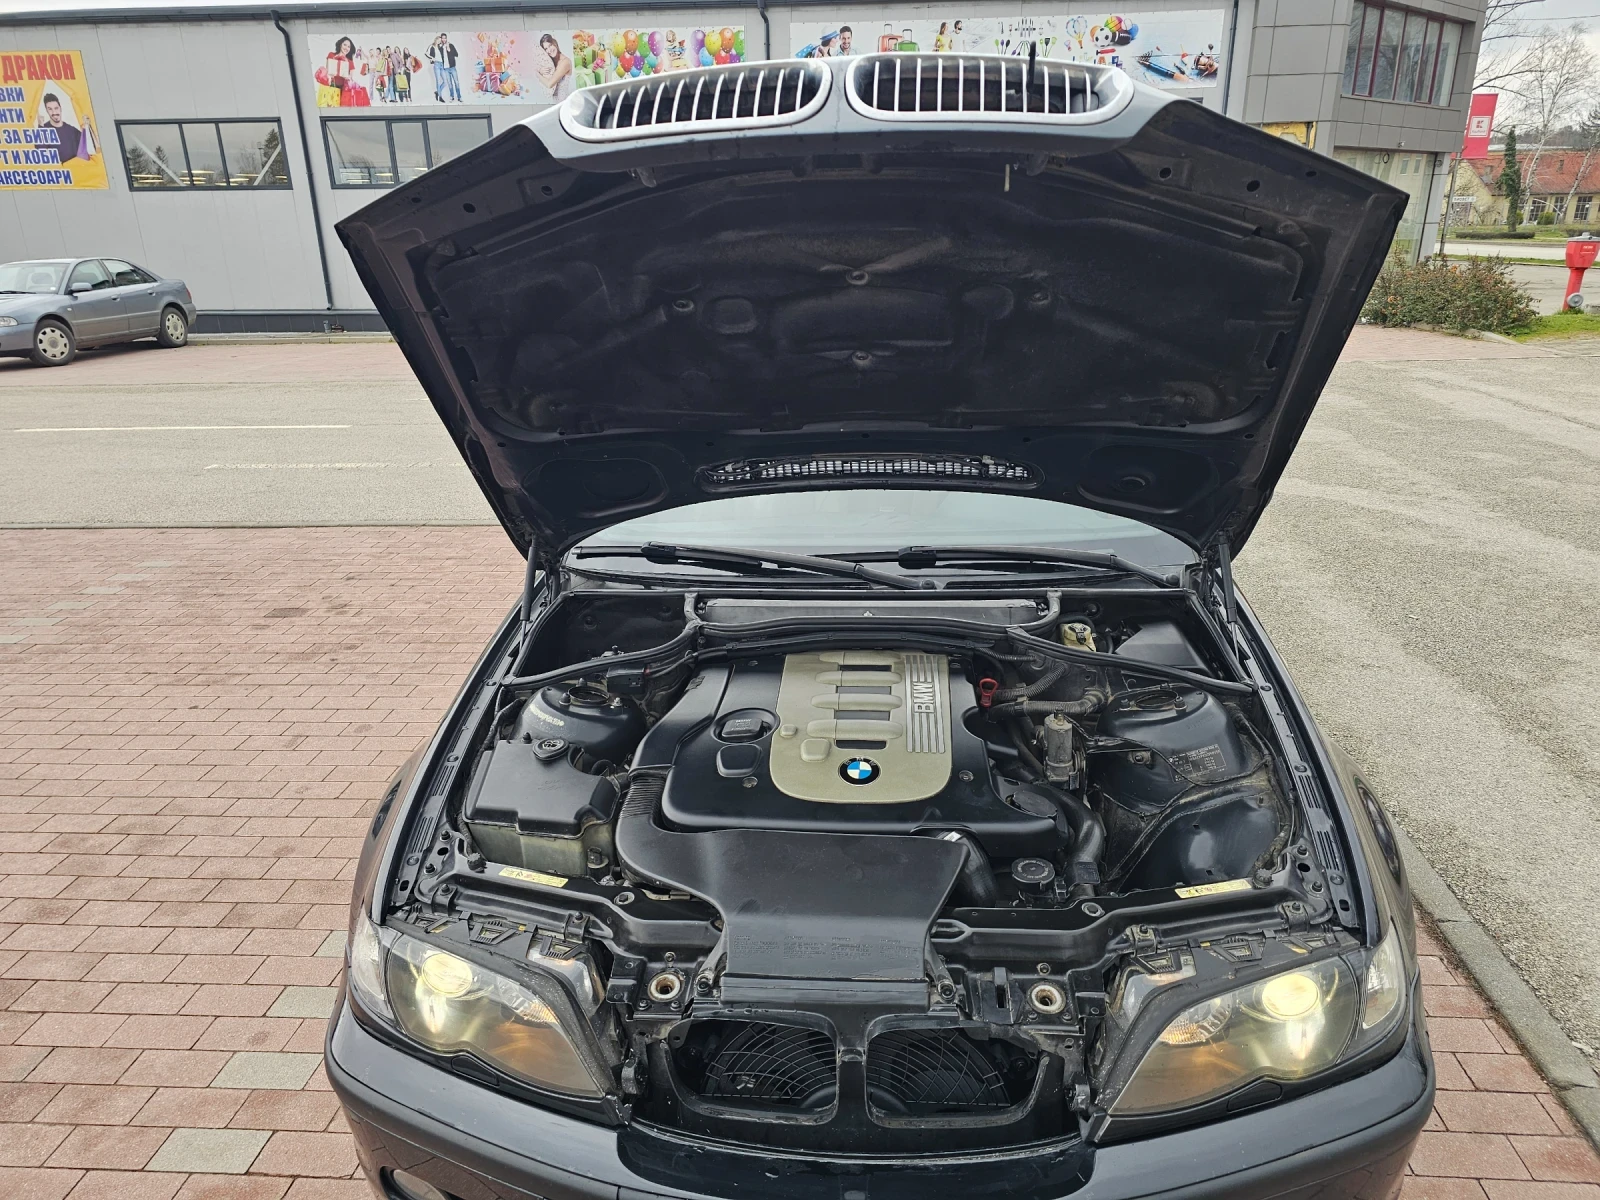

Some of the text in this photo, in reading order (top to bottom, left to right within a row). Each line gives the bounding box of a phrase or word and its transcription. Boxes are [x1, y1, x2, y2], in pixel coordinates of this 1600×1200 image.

[1, 54, 76, 83] ДРАКОН
[3, 129, 60, 144] ЗА БИТА
[11, 150, 22, 164] И
[22, 149, 60, 164] ХОБИ
[913, 682, 934, 713] BMW
